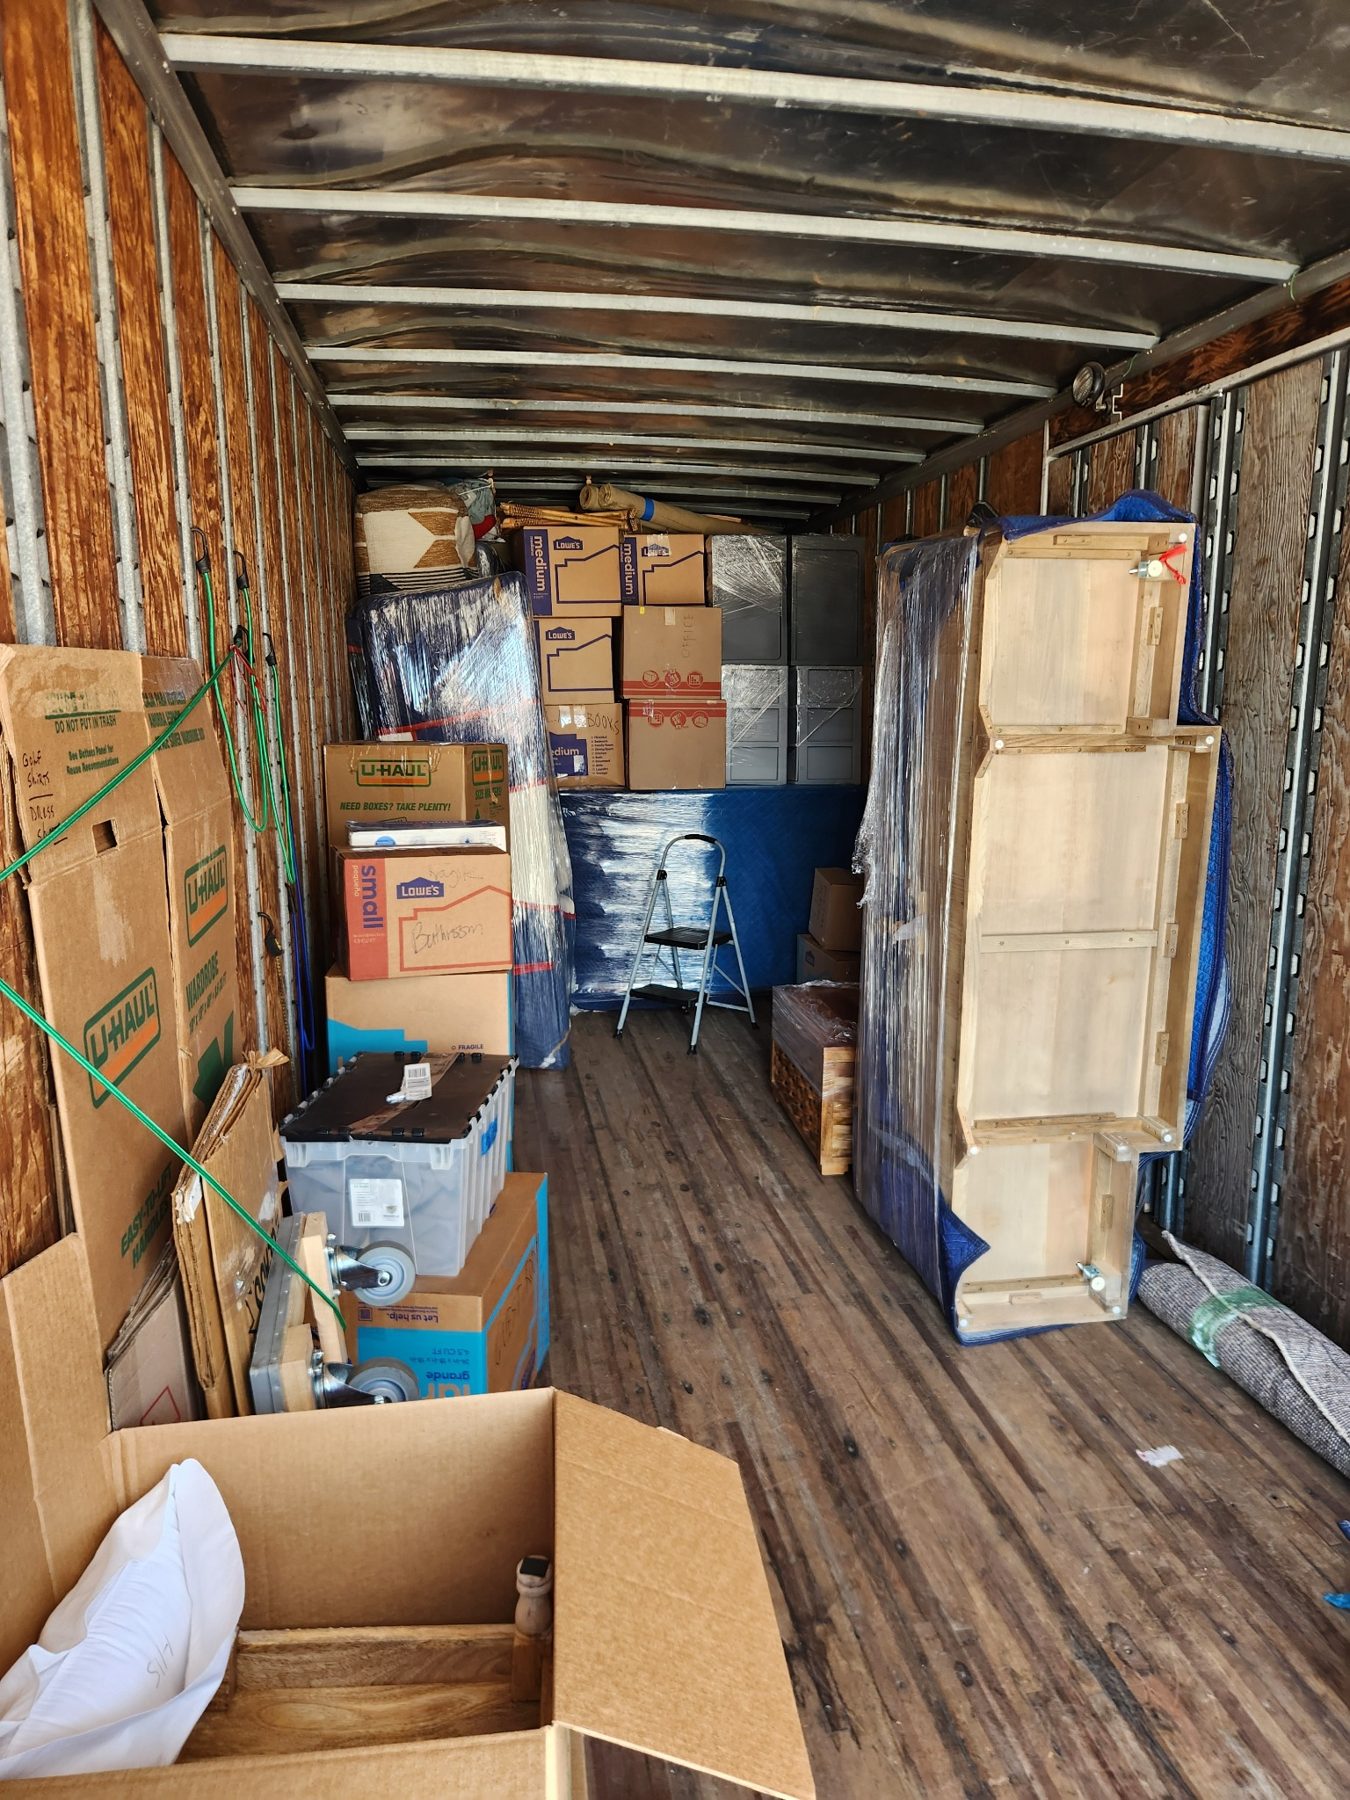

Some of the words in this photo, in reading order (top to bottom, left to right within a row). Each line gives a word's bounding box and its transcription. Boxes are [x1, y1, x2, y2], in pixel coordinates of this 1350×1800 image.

[556, 541, 581, 549] LOWE'S
[534, 536, 547, 591] medium
[623, 543, 636, 595] medium
[548, 631, 573, 639] LOWE'S
[55, 720, 65, 734] DO
[66, 719, 79, 732] NOT
[80, 717, 91, 730] PUT
[99, 715, 117, 728] TRASH
[551, 747, 580, 756] edium
[361, 764, 427, 777] U-HAUL
[340, 802, 361, 811] NEED
[363, 802, 393, 811] BOXES?
[396, 802, 416, 811] TAKE
[418, 803, 451, 811] PLENTY!
[188, 858, 225, 916] U-HAUL
[401, 885, 440, 897] LOWE'S
[362, 865, 384, 928] small
[185, 950, 219, 1013] WARDROBE
[90, 984, 155, 1070] U-HAUL
[386, 1312, 410, 1322] help.
[411, 1313, 422, 1321] us
[423, 1313, 439, 1323] Let
[425, 1370, 470, 1381] grande
